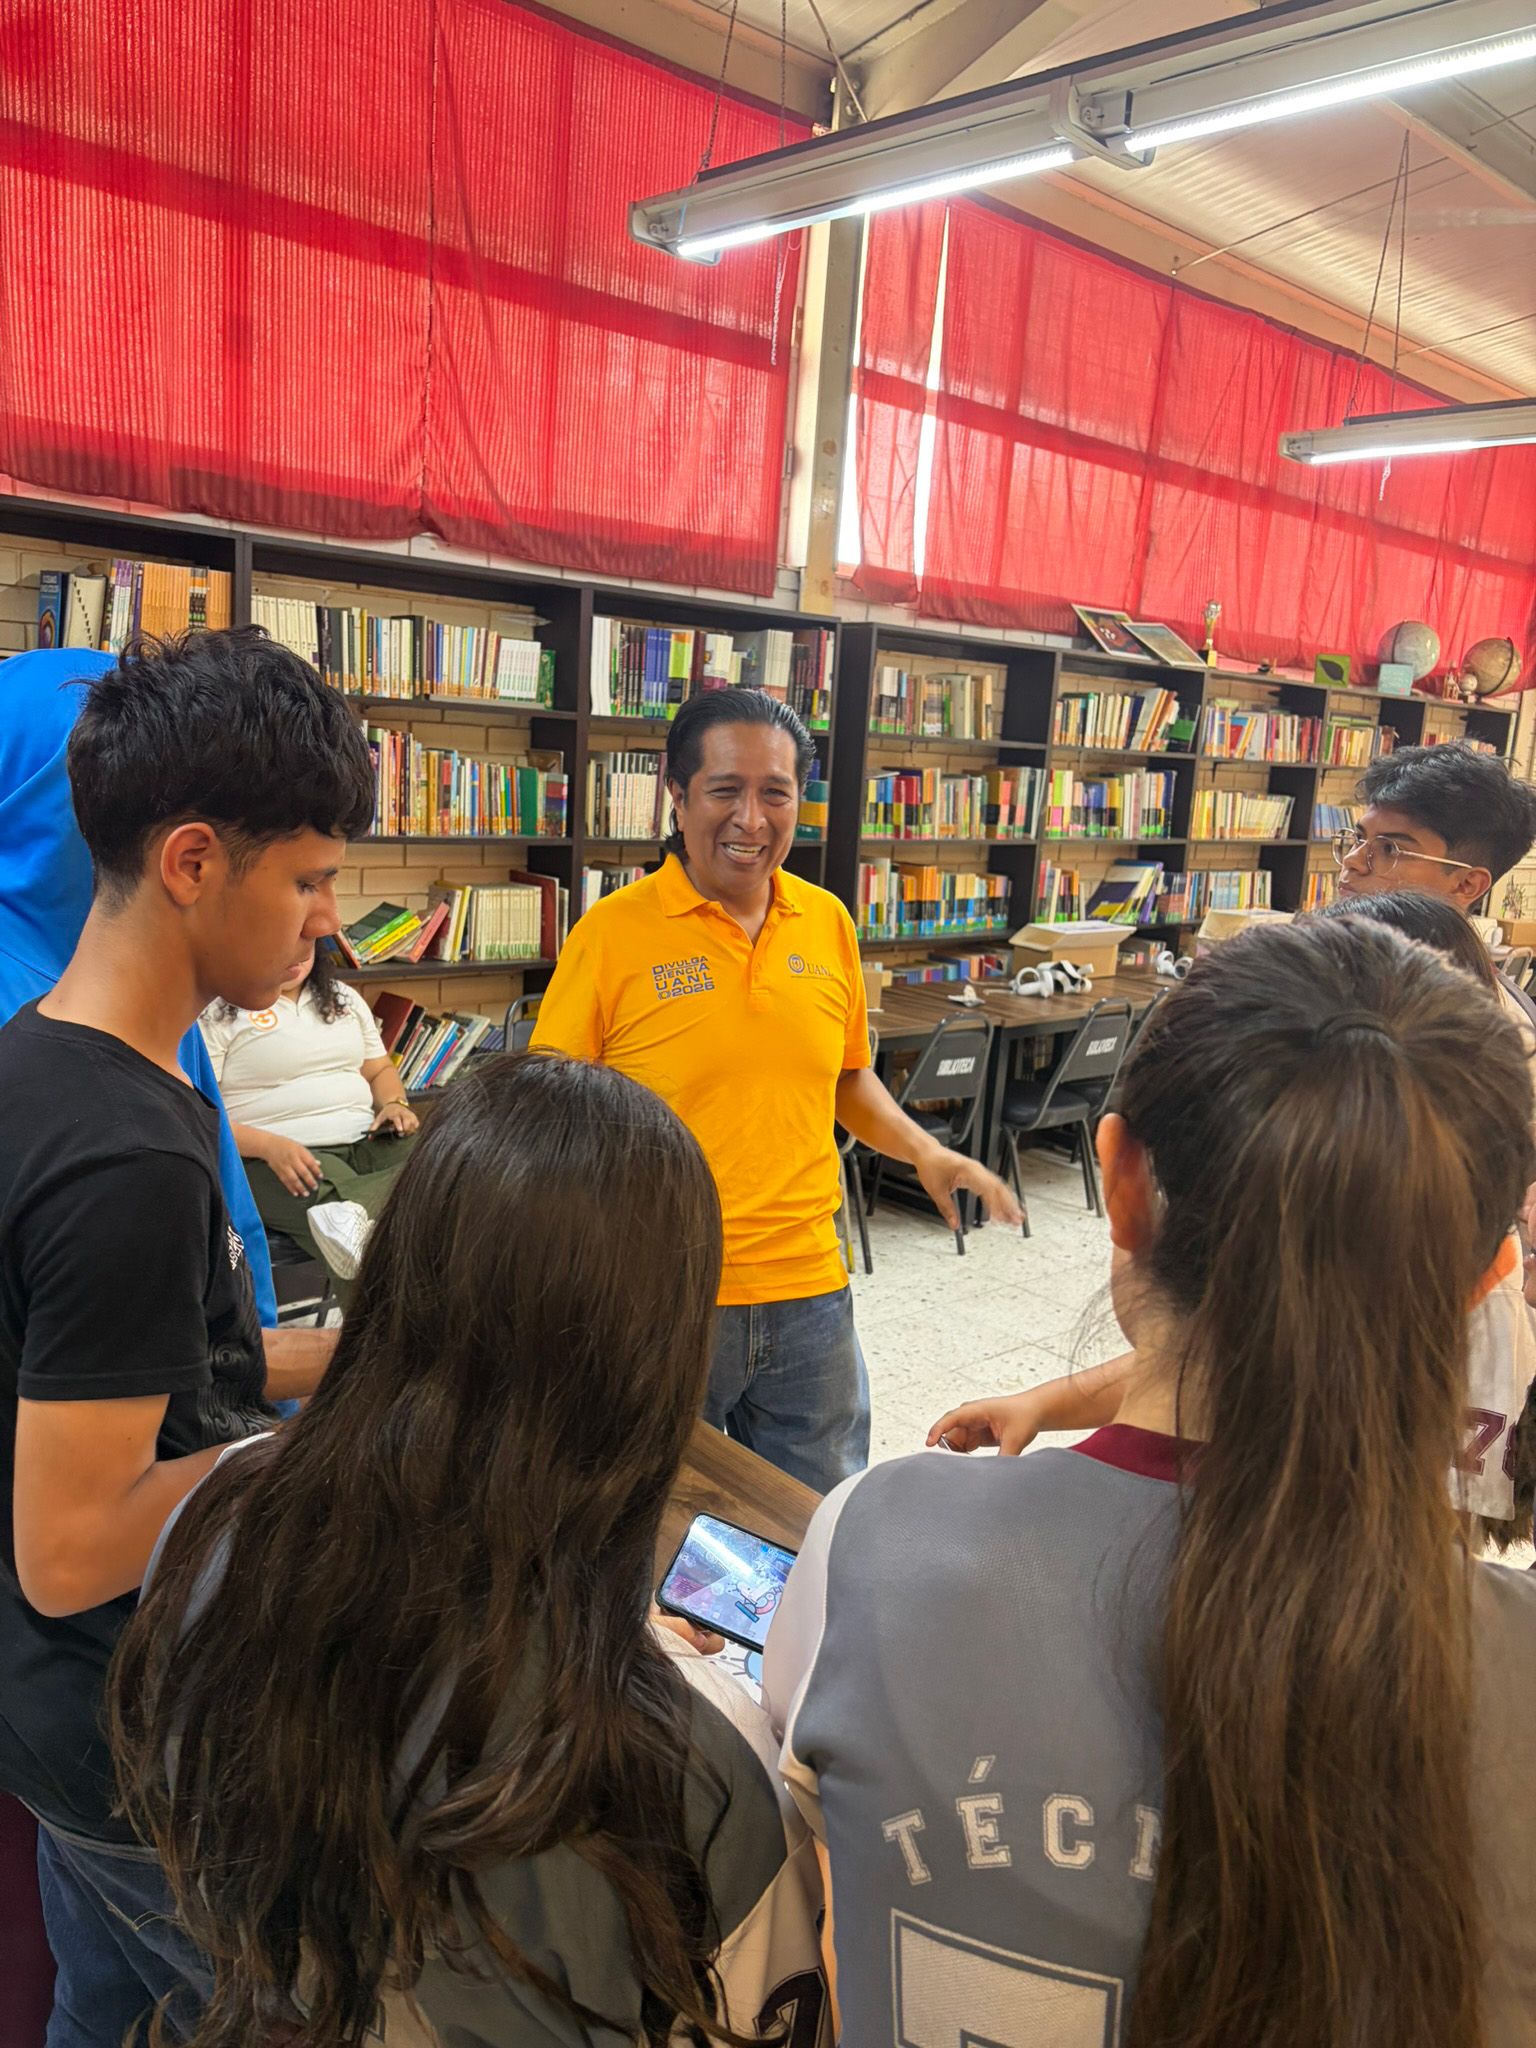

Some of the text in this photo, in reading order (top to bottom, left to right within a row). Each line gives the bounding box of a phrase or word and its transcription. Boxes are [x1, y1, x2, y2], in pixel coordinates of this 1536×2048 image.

[652, 955, 708, 975] DIVULGA
[654, 963, 710, 981] CIENCIA
[656, 972, 713, 990] UANL
